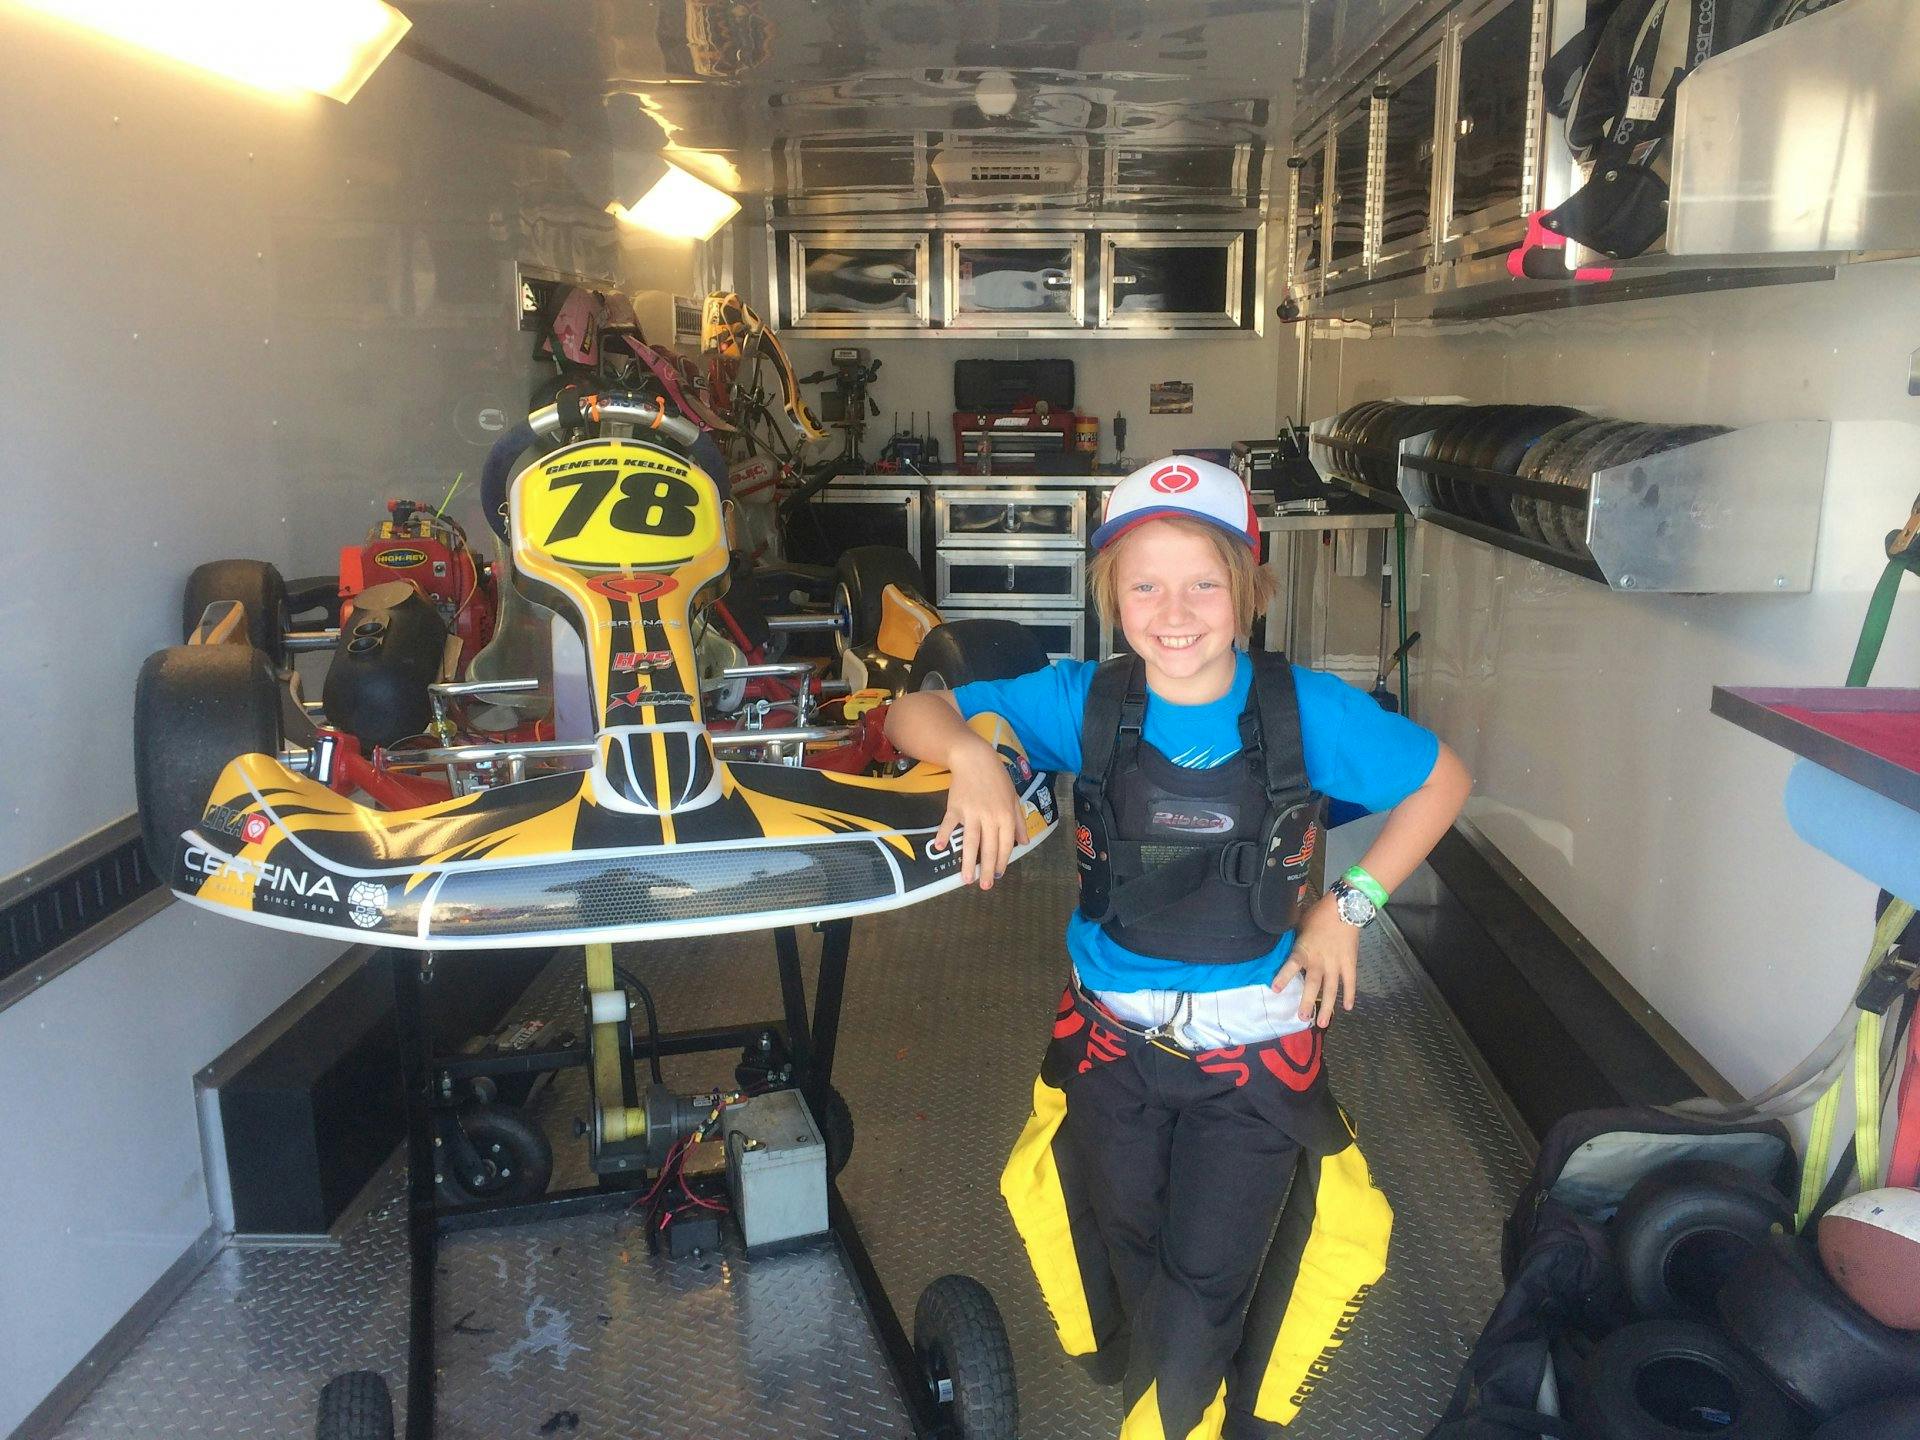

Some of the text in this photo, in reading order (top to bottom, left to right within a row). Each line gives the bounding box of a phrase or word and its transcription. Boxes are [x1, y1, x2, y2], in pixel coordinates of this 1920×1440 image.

[545, 458, 689, 477] GENEVA KELLER
[543, 469, 700, 547] 78
[378, 554, 425, 563] HIGH-REV
[183, 846, 340, 902] CERTINA
[263, 894, 335, 915] SINCE 1888
